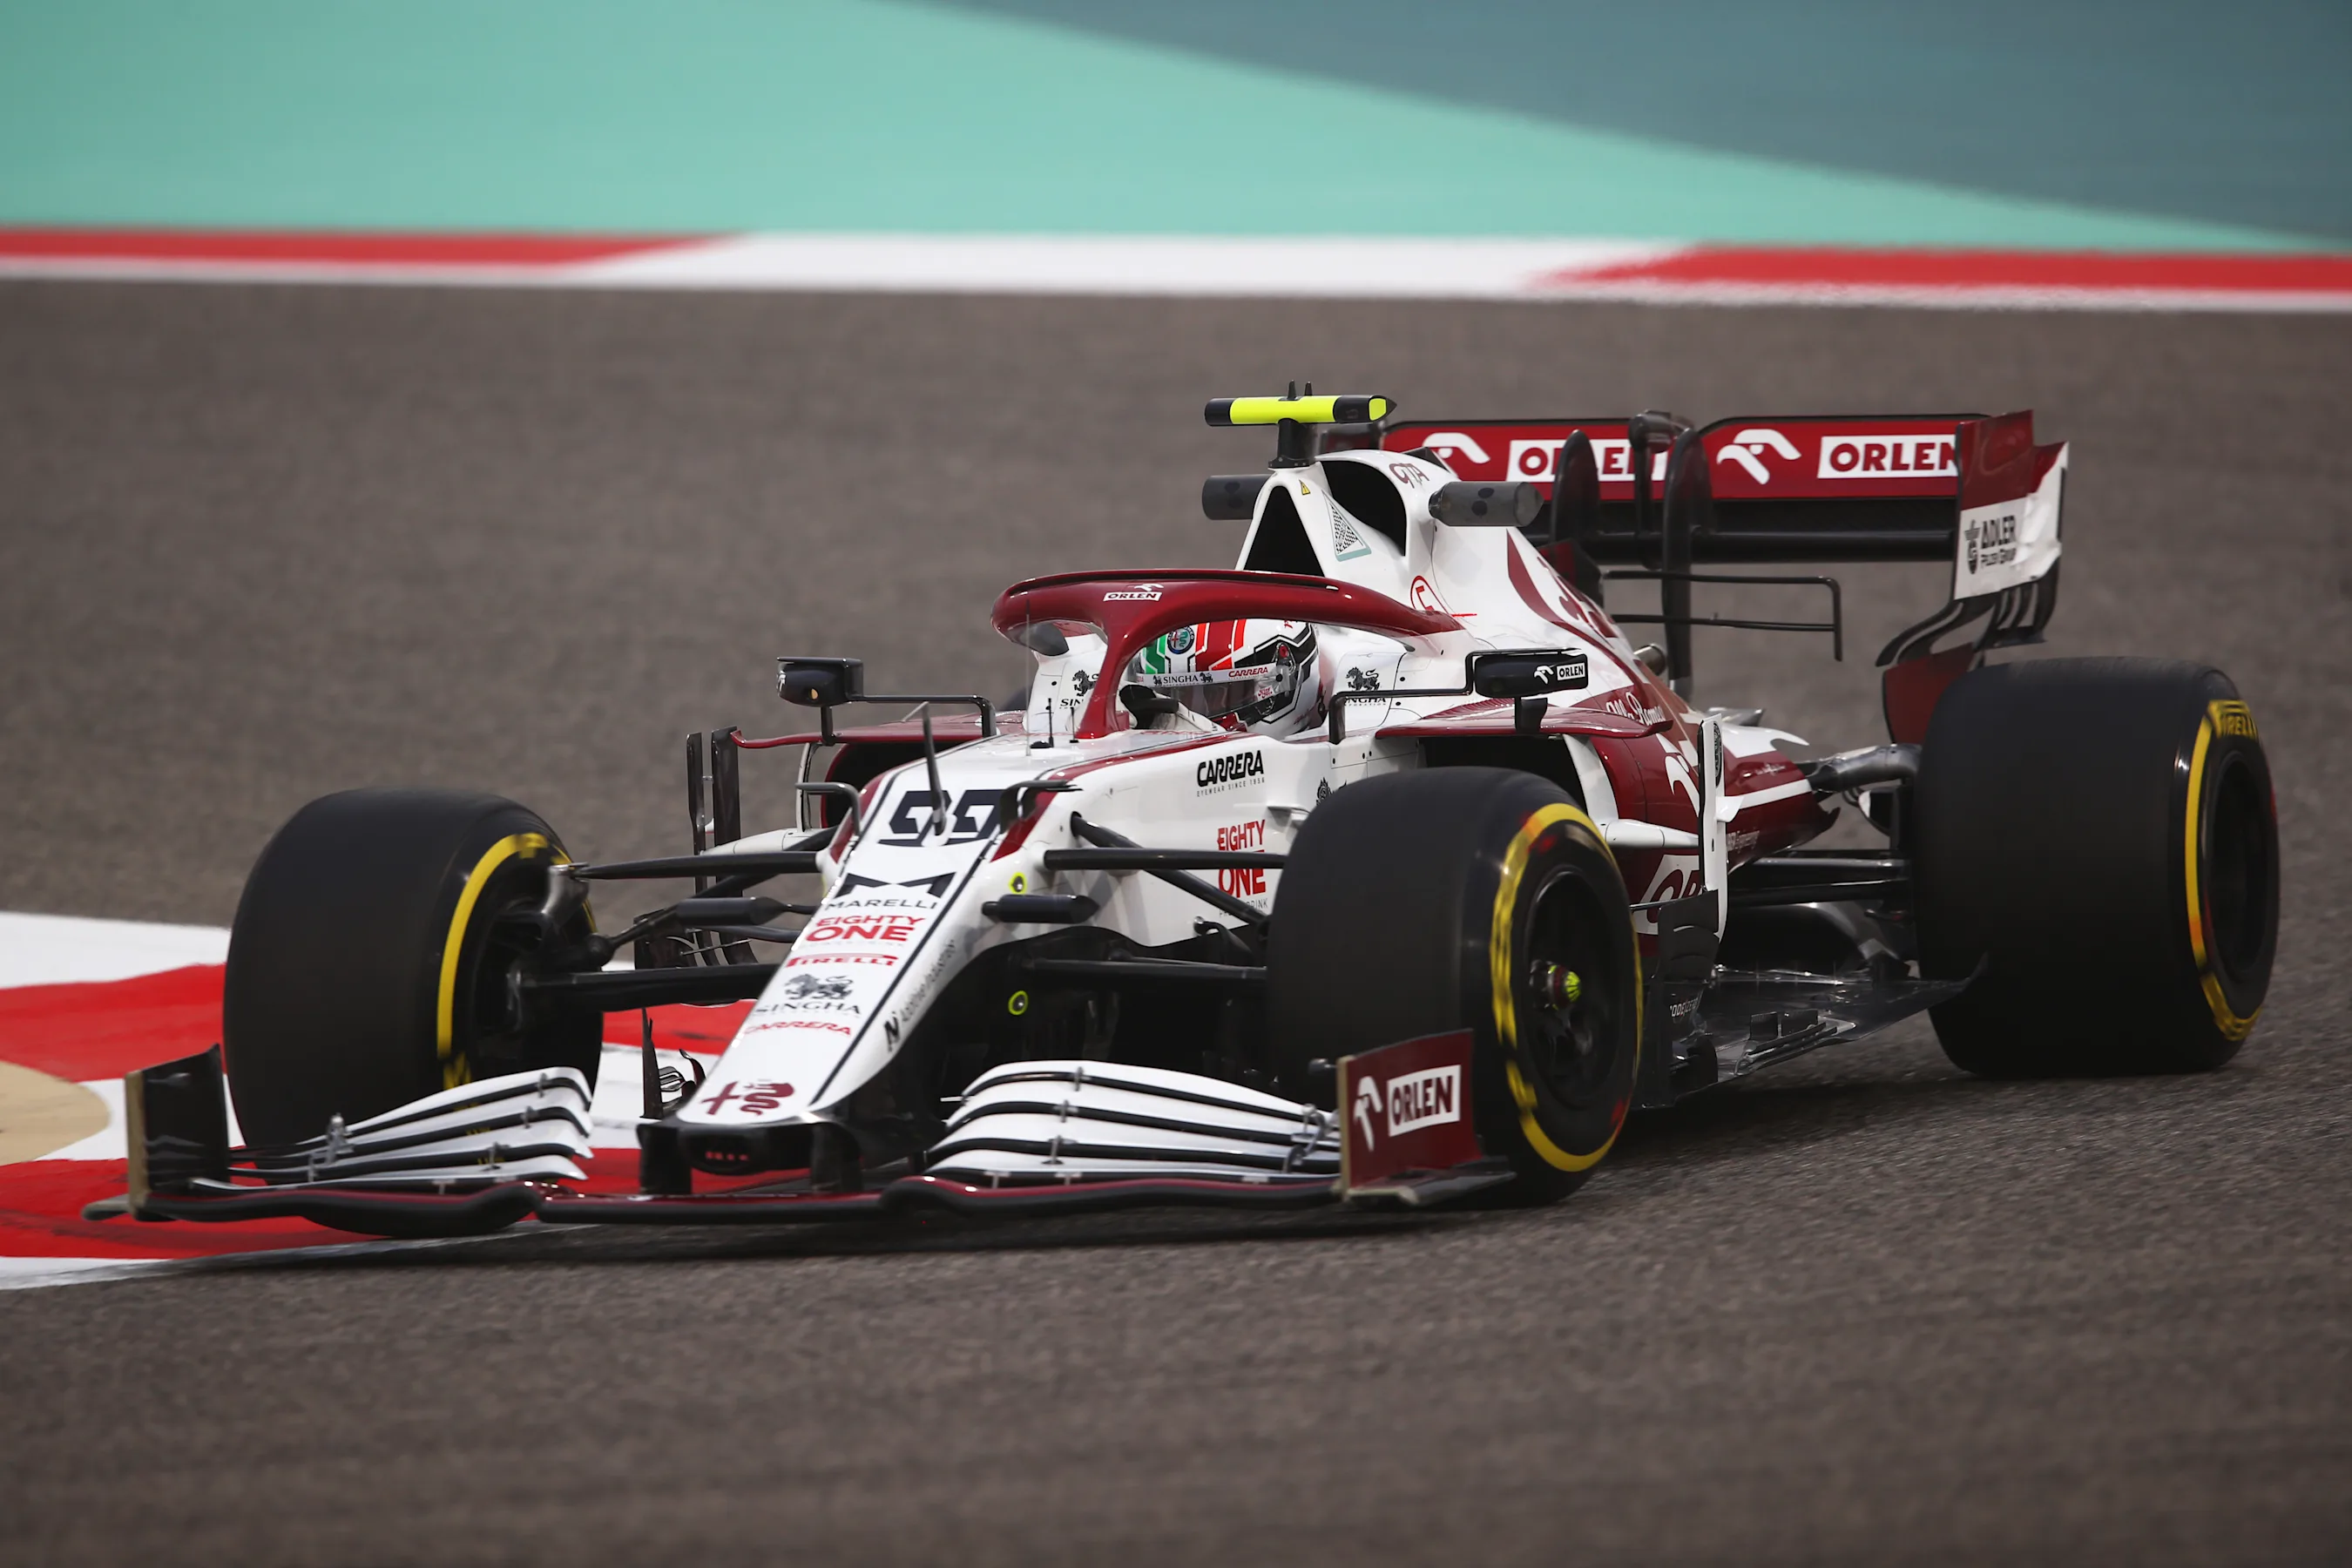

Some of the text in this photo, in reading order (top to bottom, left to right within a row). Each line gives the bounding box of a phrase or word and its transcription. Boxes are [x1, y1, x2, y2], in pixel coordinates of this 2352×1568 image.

[1829, 443, 1956, 472] ORLEN
[1981, 515, 2016, 549] ADLER
[1163, 675, 1199, 684] SINGHA
[1228, 666, 1268, 678] CARRERA
[1559, 665, 1584, 678] ORLEN
[1197, 750, 1264, 787] CARRERA
[877, 789, 1002, 847] 99
[1217, 819, 1266, 851] EIGHTY
[1219, 868, 1266, 898] ONE
[825, 899, 937, 910] MARELLI
[815, 915, 926, 928] EIGHTY
[806, 925, 916, 942] ONE
[786, 952, 899, 968] PIRELLI
[754, 1002, 861, 1015] SINGHA
[744, 1021, 851, 1037] CARRERA
[1392, 1074, 1454, 1126] ORLEN
